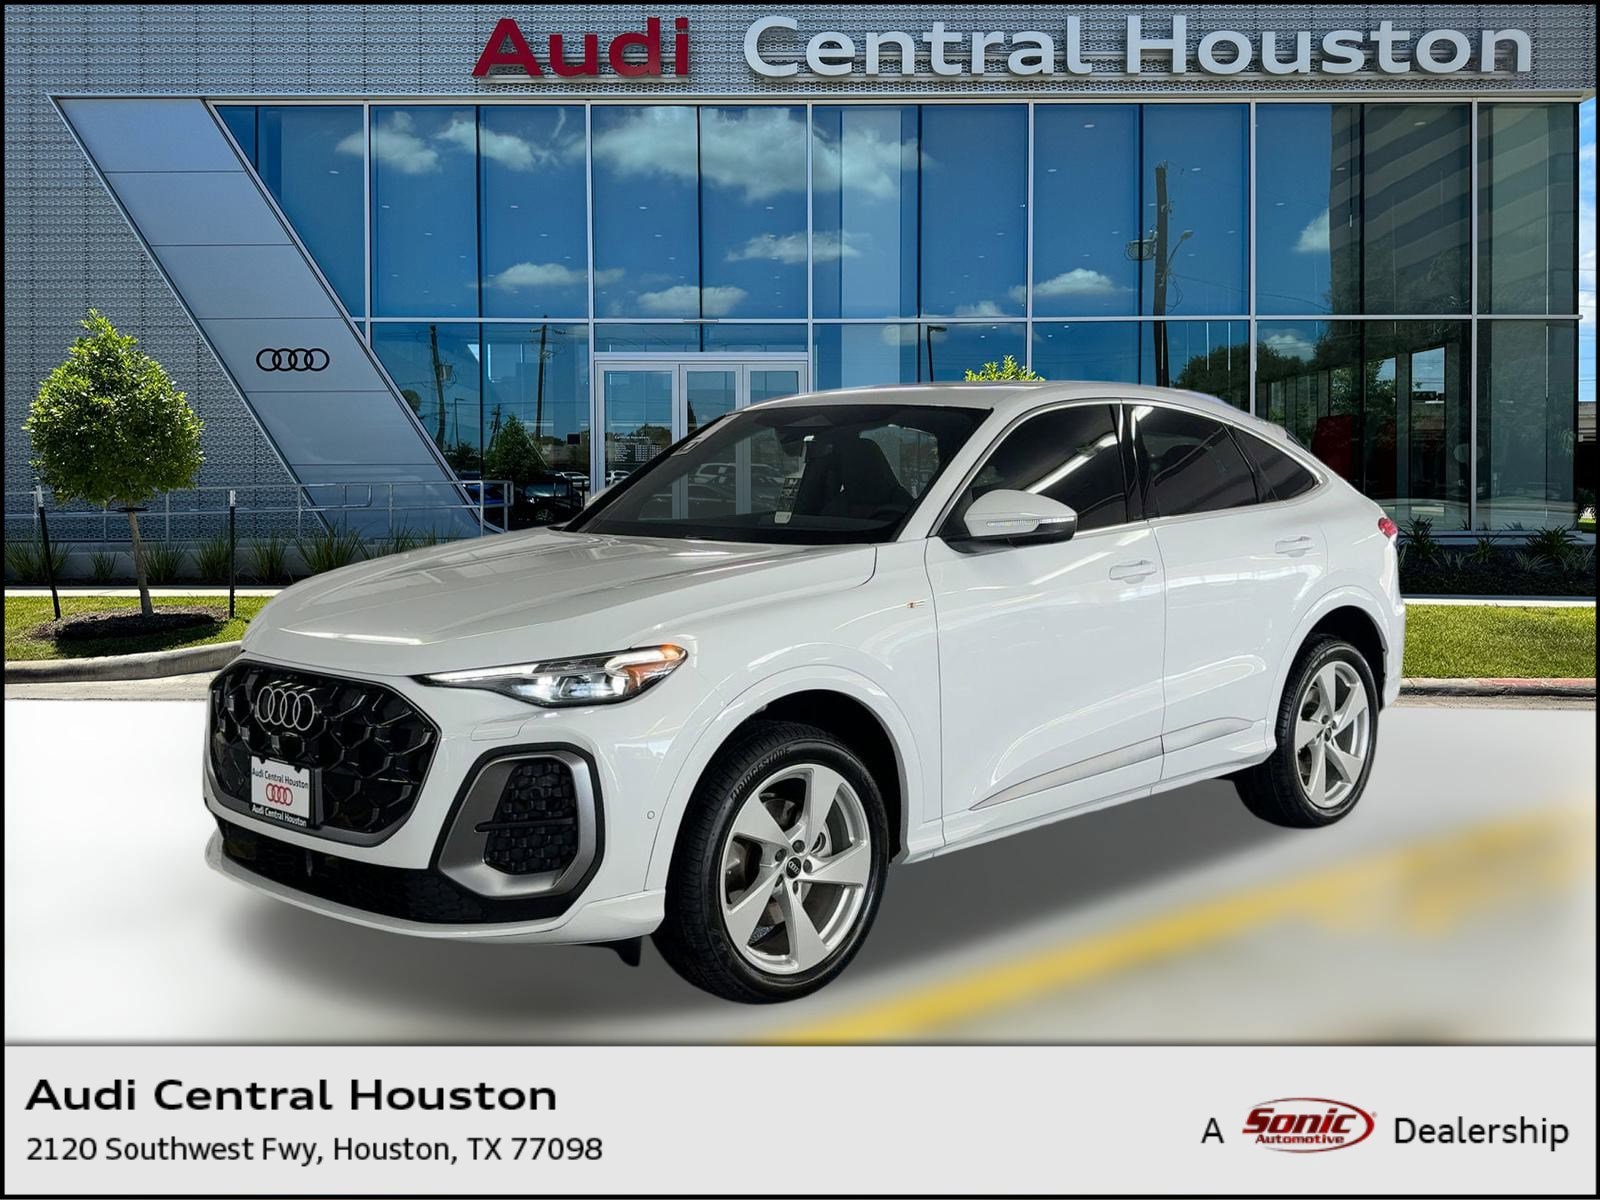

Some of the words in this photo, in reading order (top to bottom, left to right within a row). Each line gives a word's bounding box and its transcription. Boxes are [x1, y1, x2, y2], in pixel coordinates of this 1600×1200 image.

[472, 17, 689, 78] Audi
[744, 16, 1092, 76] Central
[1126, 15, 1531, 75] Houston
[252, 767, 264, 778] Audi
[264, 770, 284, 784] Central
[284, 775, 309, 789] Houston
[252, 804, 264, 815] Audi
[265, 807, 284, 820] Central
[284, 812, 307, 827] Houston
